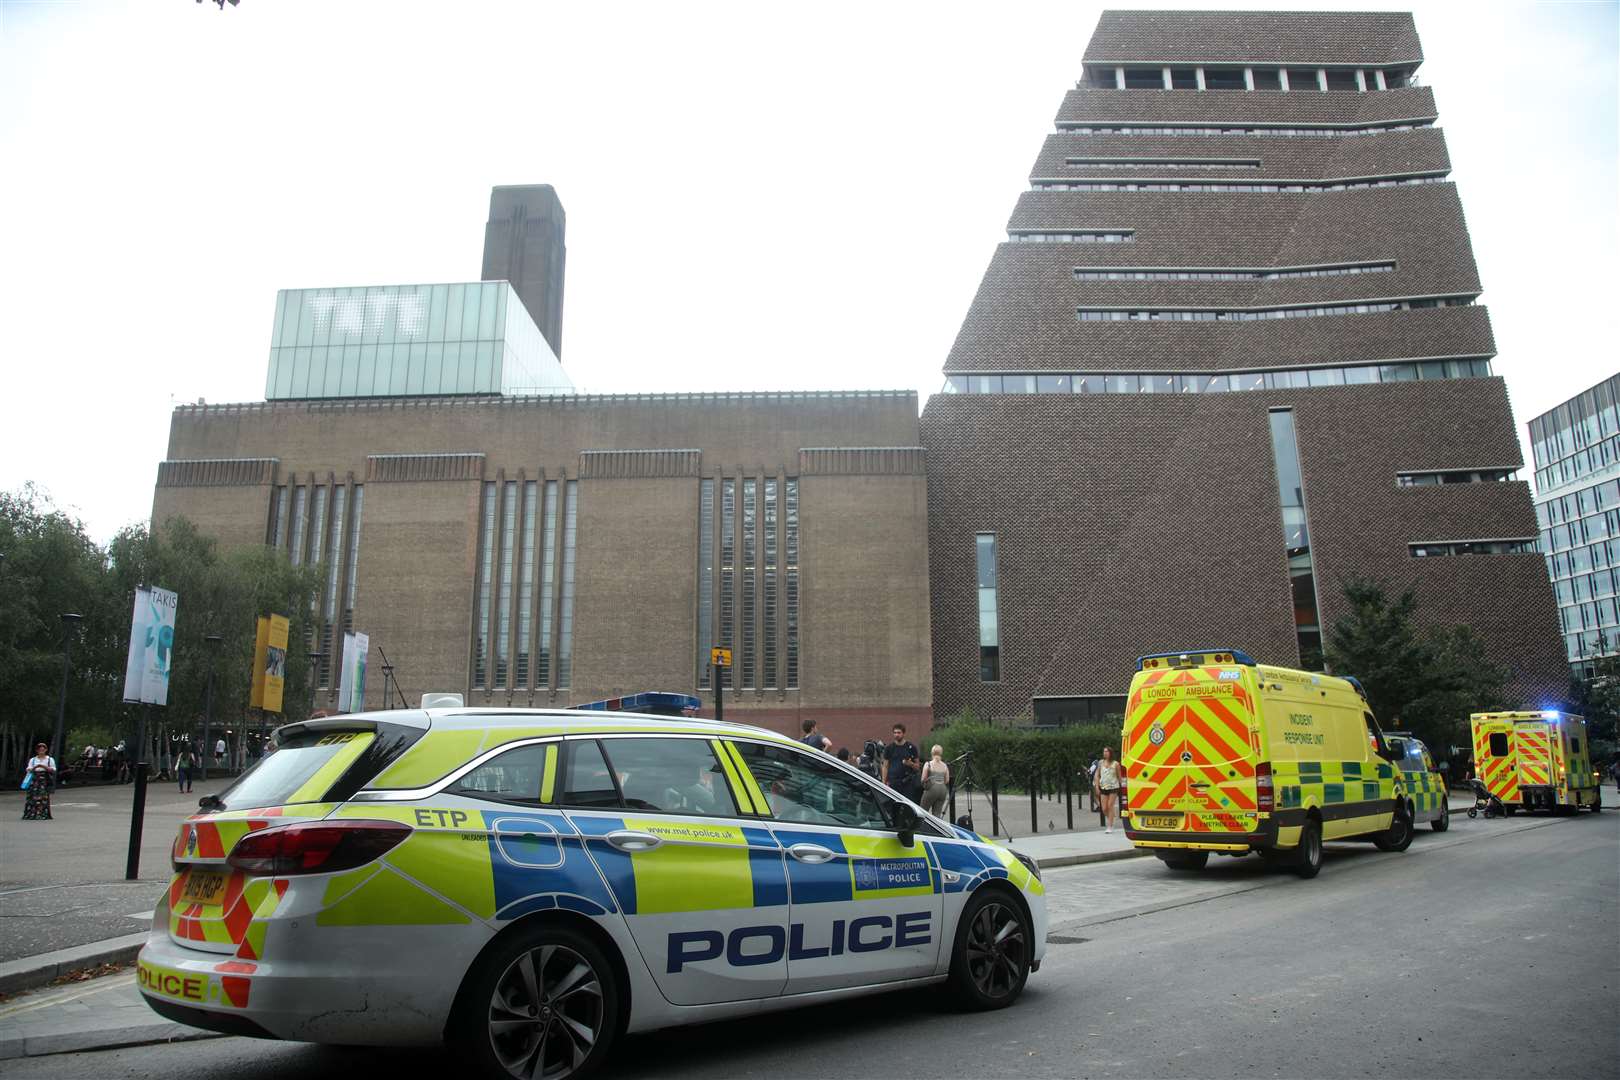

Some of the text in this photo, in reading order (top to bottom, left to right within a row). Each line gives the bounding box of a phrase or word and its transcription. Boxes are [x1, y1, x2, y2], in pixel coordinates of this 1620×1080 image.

[152, 591, 176, 609] TAKIS
[1219, 671, 1240, 680] NHS
[1147, 684, 1233, 698] LONDON AMBULANCE
[1289, 713, 1312, 726] INCIDENT
[1284, 732, 1325, 745] RESPONSE UNIT
[415, 809, 468, 828] ETP
[646, 826, 734, 840] www.met.police.uk
[880, 862, 925, 871] METROPOLITAN
[888, 873, 921, 883] POLICE
[666, 911, 932, 974] POLICE
